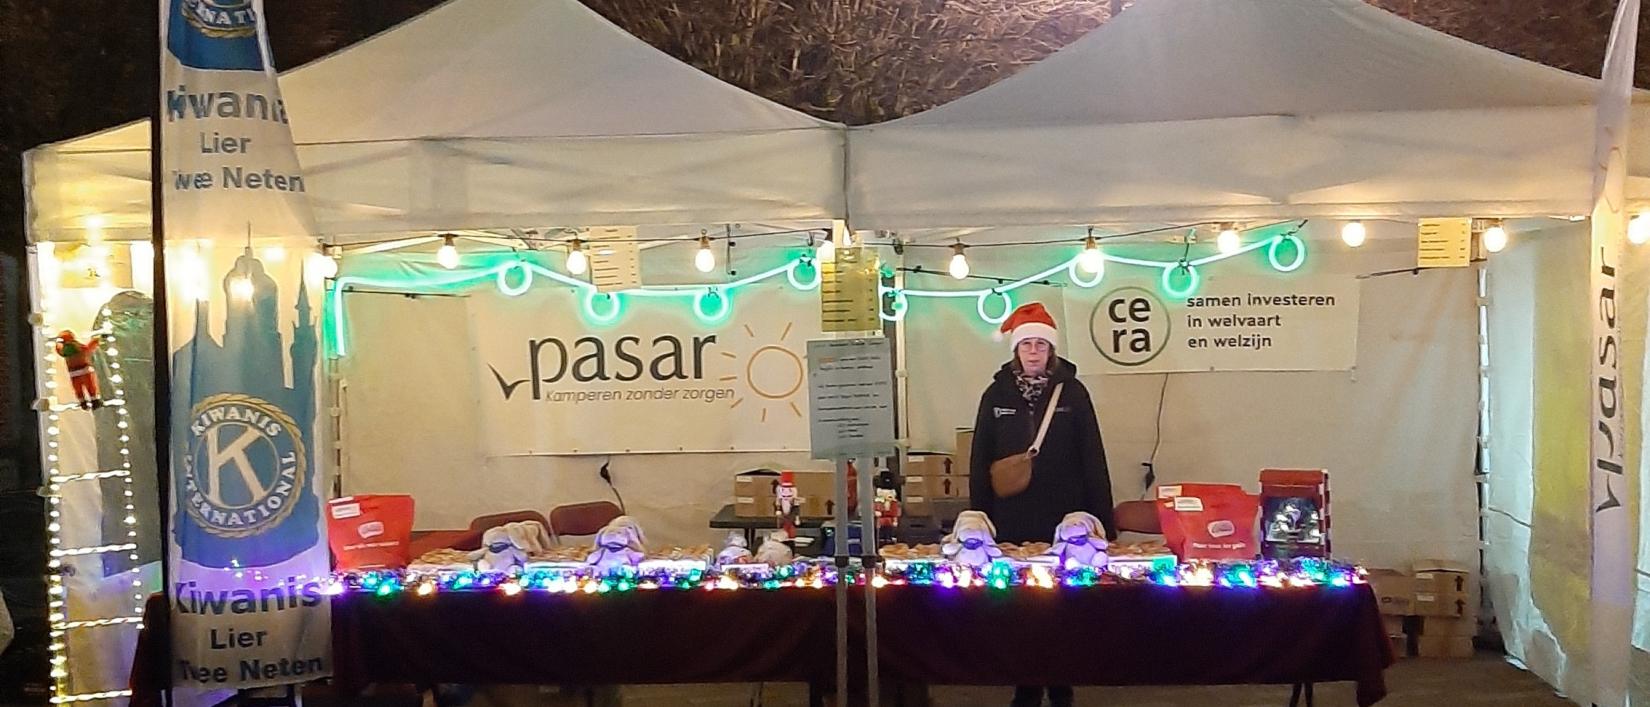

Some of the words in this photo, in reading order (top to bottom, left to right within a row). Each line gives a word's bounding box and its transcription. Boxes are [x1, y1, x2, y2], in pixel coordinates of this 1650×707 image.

[201, 132, 251, 153] Lier
[173, 168, 213, 189] wee
[222, 166, 305, 192] Neten
[1186, 294, 1241, 308] samen
[1248, 293, 1336, 307] investeren
[1187, 315, 1202, 328] in
[1208, 314, 1282, 328] welvaart
[1187, 337, 1207, 349] en
[1214, 334, 1272, 350] welzijn
[528, 334, 717, 400] pasar
[546, 389, 622, 404] Kamperen
[626, 386, 680, 401] zonder
[682, 387, 736, 403] zorgen
[191, 406, 282, 437] KIWANIS
[206, 425, 268, 506] K
[210, 628, 268, 650] Lier
[239, 656, 323, 682] Neten
